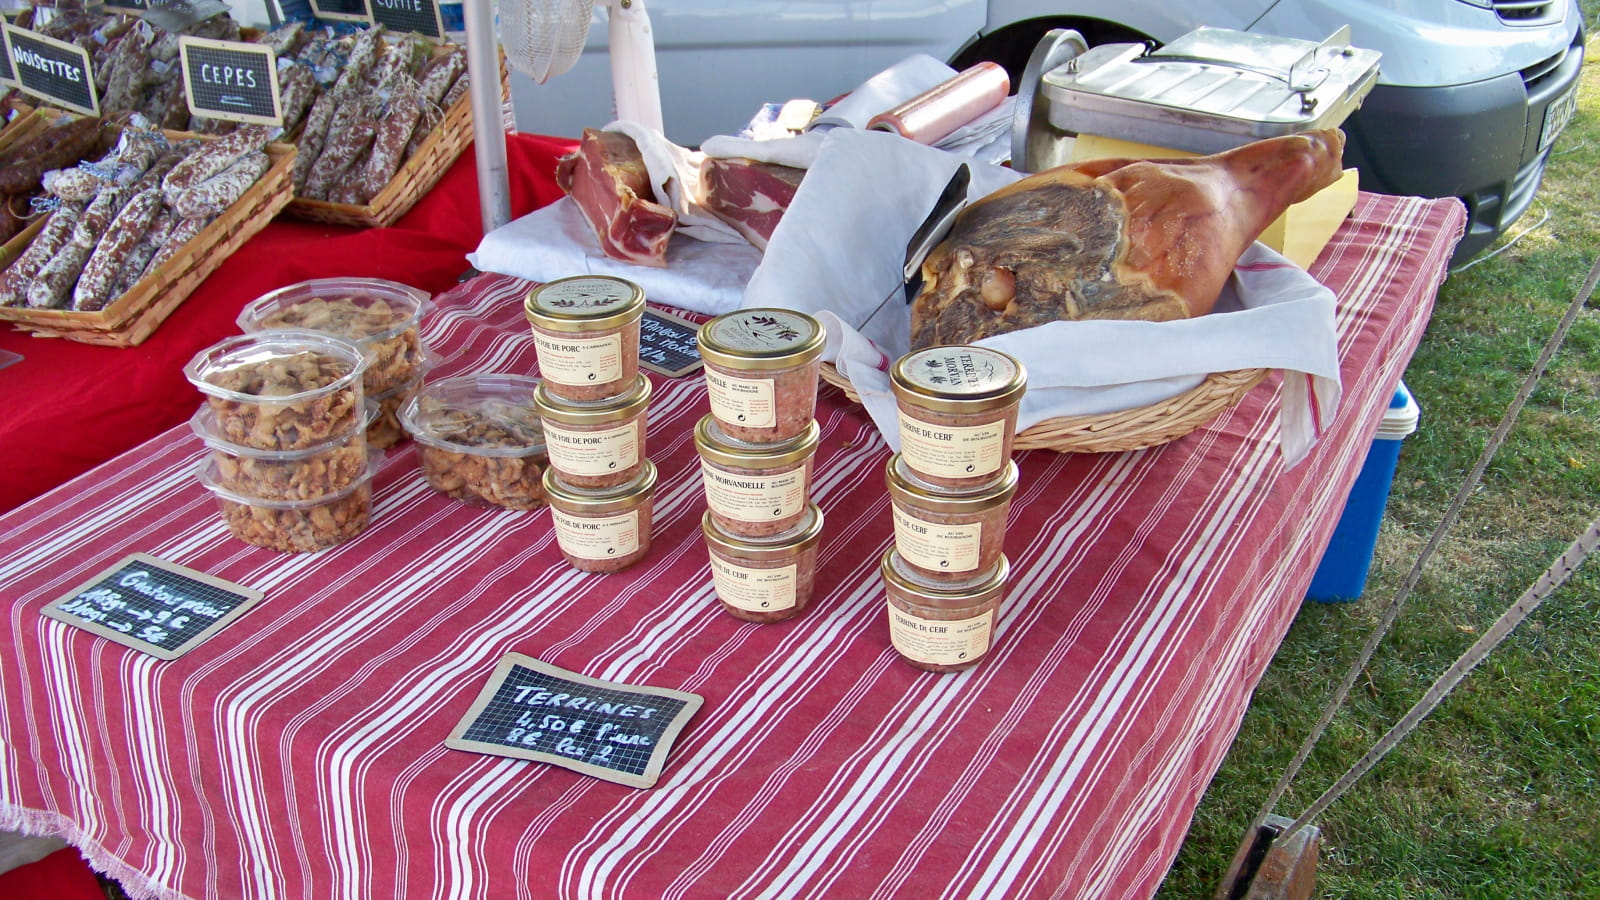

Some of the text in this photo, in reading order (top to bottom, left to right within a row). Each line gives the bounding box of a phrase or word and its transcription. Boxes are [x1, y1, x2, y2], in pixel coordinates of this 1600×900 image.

[14, 45, 80, 82] NOISETTES
[202, 63, 256, 88] CEPES
[552, 343, 560, 351] DE
[561, 344, 581, 353] PORC
[572, 437, 582, 445] DE
[583, 437, 603, 445] PORC
[922, 429, 932, 439] DE
[933, 432, 954, 442] CERF
[715, 475, 766, 490] MORVANDELLE
[572, 521, 581, 529] DE
[582, 523, 601, 531] PORC
[911, 523, 929, 535] CERF
[732, 570, 750, 580] CERF
[895, 614, 918, 630] TERRINE
[929, 626, 949, 634] CERF
[514, 685, 658, 719] TERRINES
